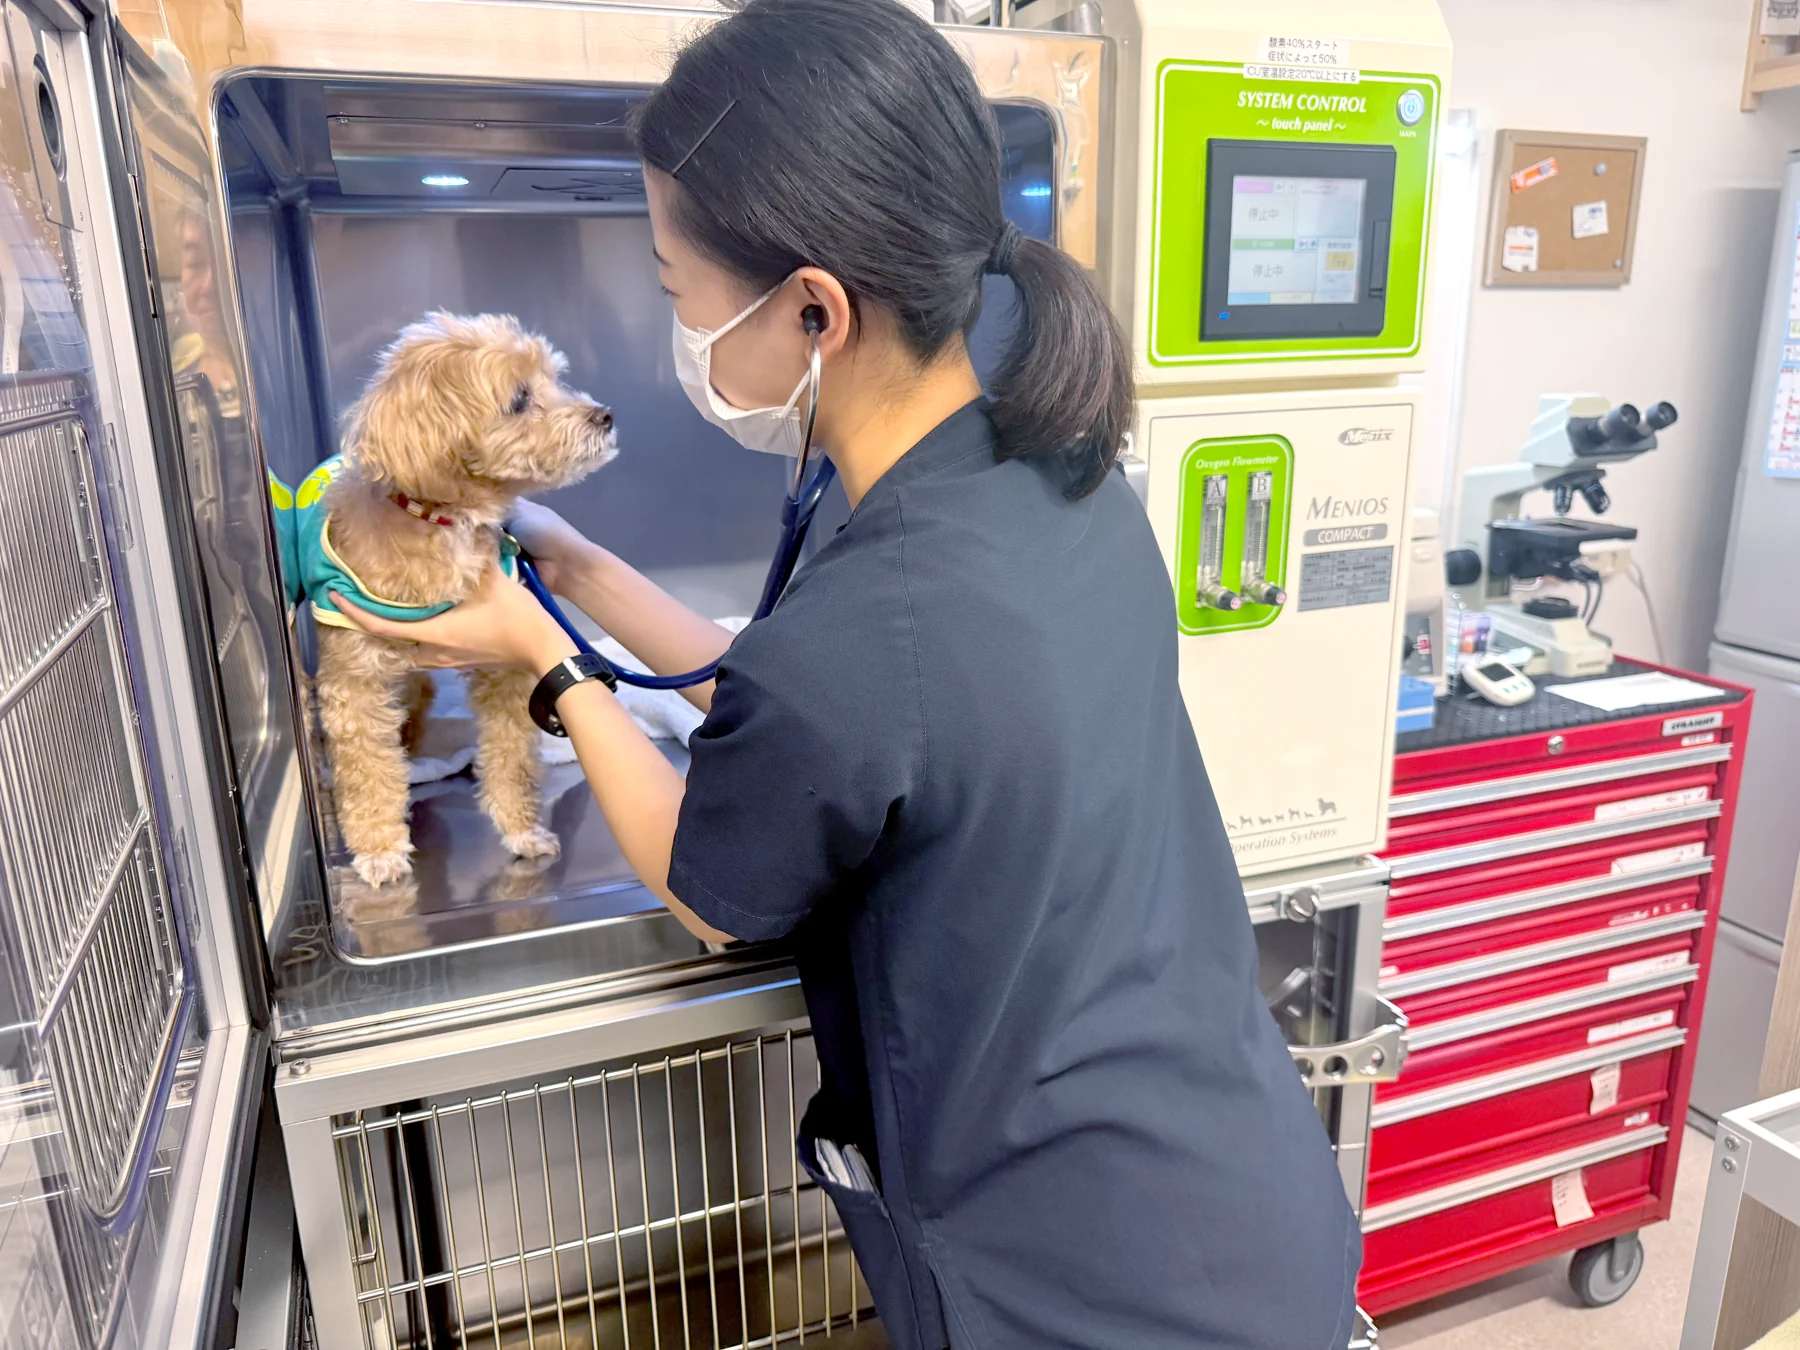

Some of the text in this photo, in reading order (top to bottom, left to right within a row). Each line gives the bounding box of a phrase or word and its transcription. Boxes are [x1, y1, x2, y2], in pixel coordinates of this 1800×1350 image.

[1268, 36, 1338, 51] 酸素40%スタート
[1267, 50, 1338, 65] 症状によって50%
[1237, 91, 1367, 113] SYSTEM CONTROL
[1271, 117, 1300, 131] touch
[1302, 119, 1333, 133] panel
[1195, 455, 1279, 470] Oxygen Flowmeter
[1209, 482, 1222, 497] A
[1257, 478, 1267, 493] B
[1306, 495, 1388, 521] MENIOS
[1317, 526, 1375, 544] COMPACT
[1289, 826, 1337, 845] Systems
